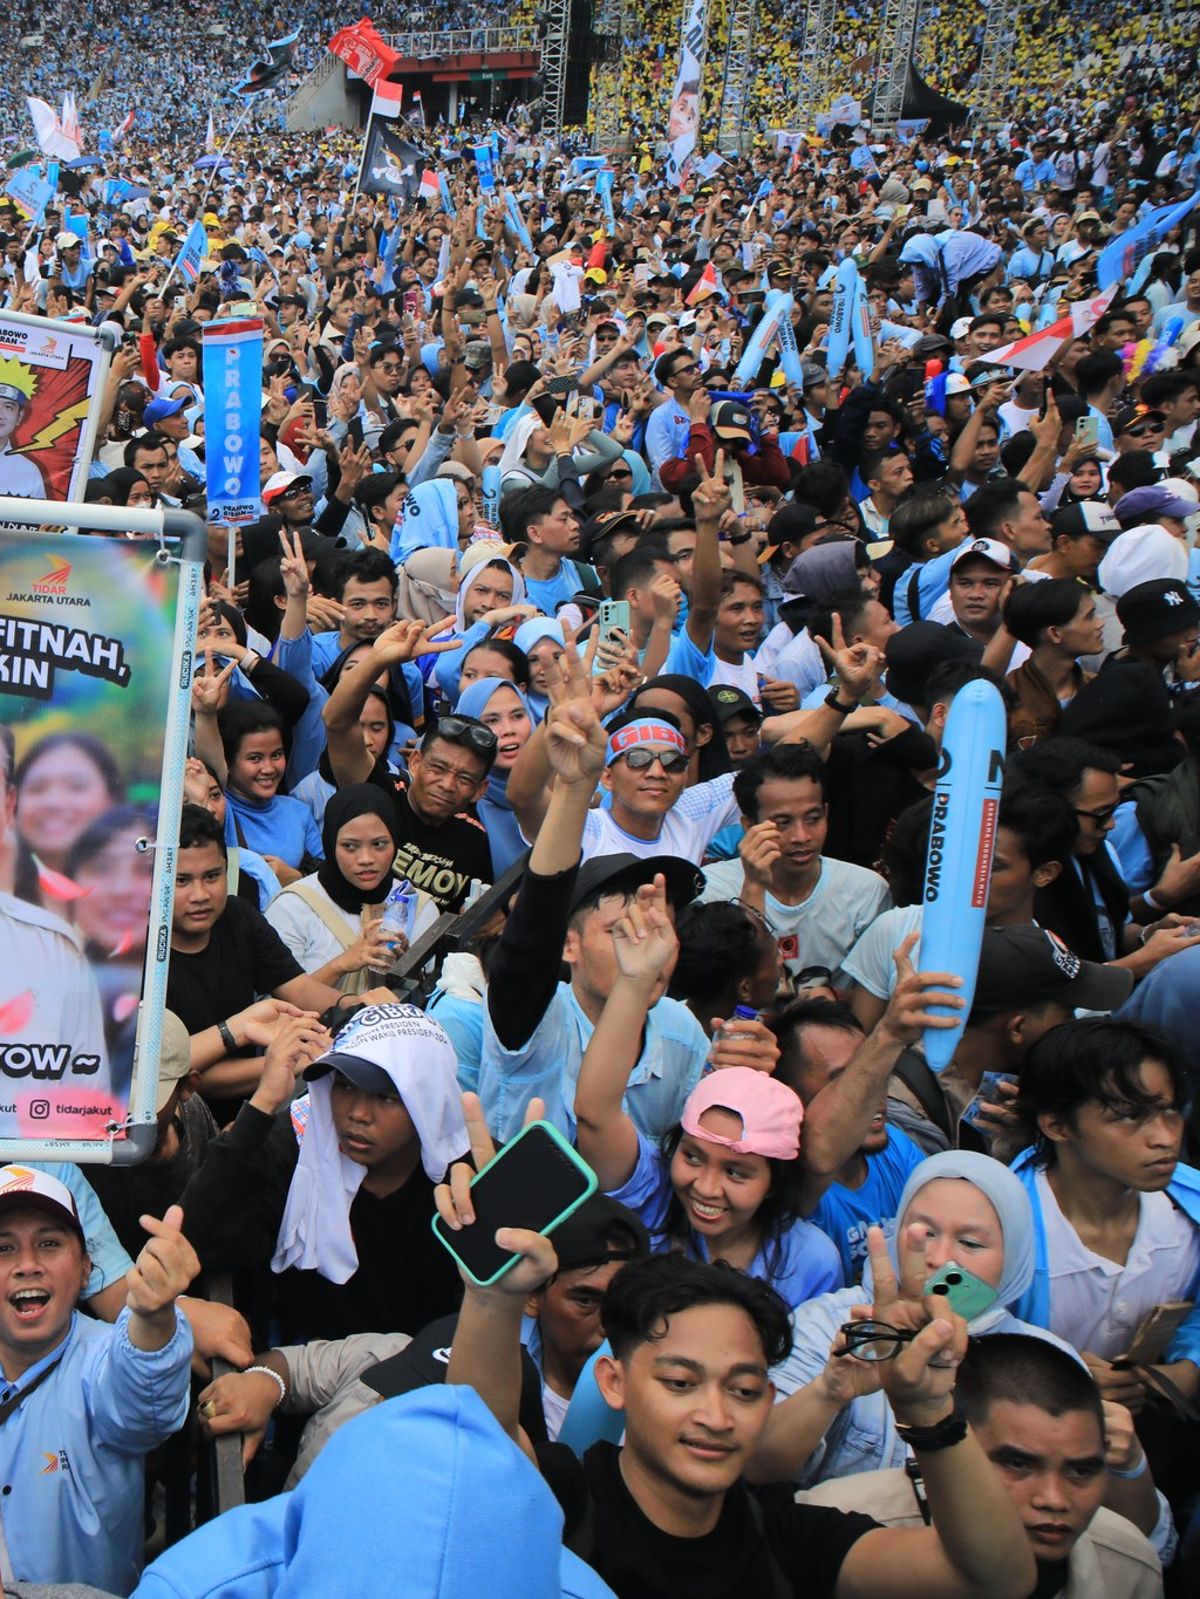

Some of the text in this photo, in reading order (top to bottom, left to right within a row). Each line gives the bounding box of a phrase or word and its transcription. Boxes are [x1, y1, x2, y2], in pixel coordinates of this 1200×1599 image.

[223, 347, 244, 497] PRABOWO
[210, 508, 220, 521] 2
[32, 584, 66, 595] TIDAR
[6, 592, 91, 607] JAKARTA UTARA
[181, 653, 191, 687] RUCIKA
[926, 792, 950, 903] PRABOWO
[380, 1020, 420, 1030] PRESIDEN
[369, 1030, 396, 1042] WAKIL
[56, 1103, 113, 1117] tidarjakut
